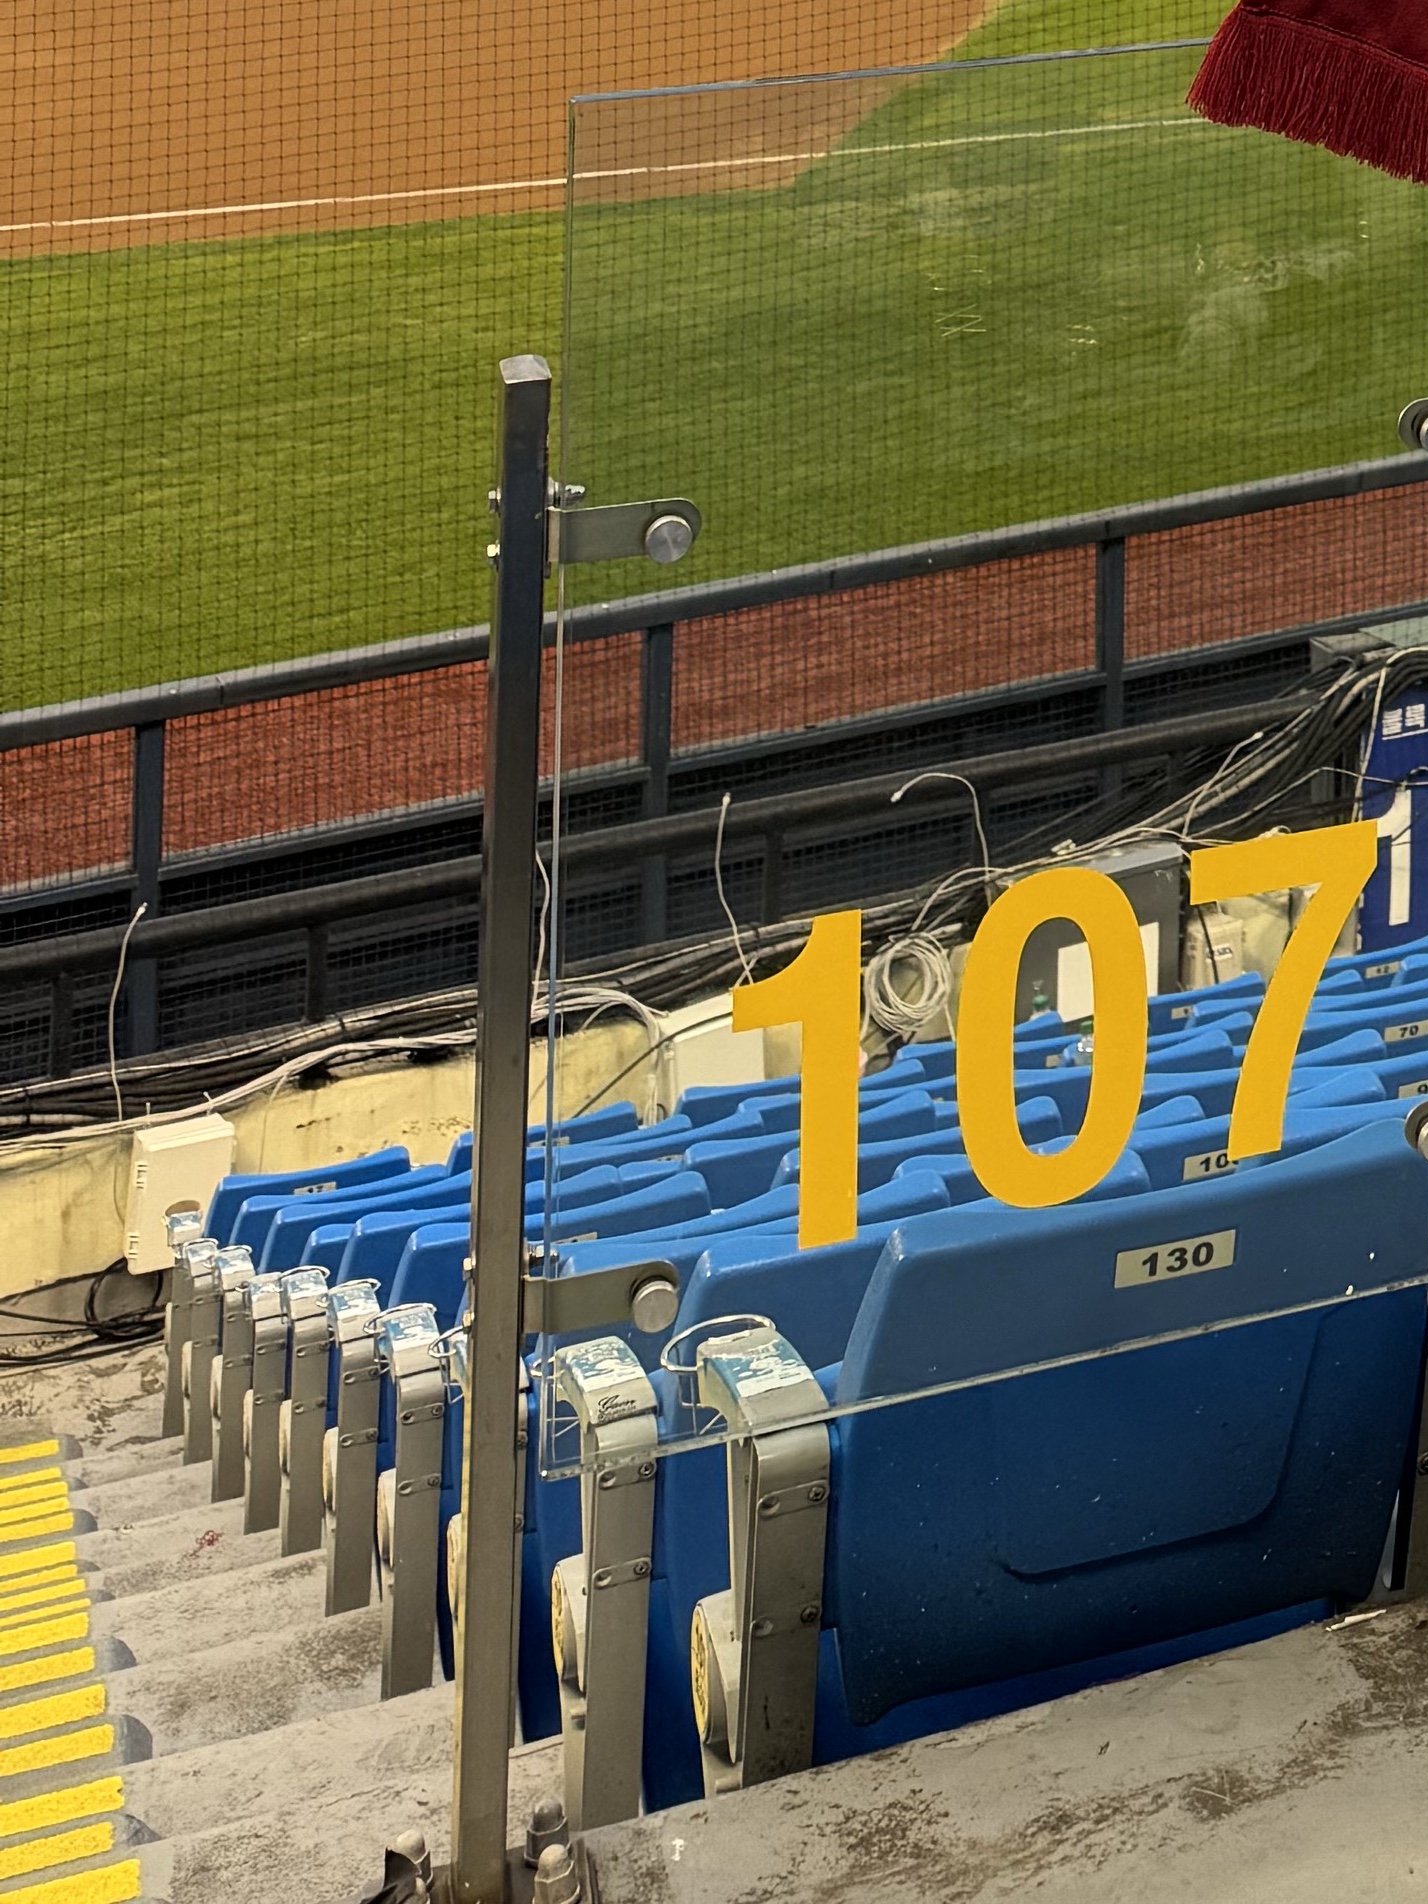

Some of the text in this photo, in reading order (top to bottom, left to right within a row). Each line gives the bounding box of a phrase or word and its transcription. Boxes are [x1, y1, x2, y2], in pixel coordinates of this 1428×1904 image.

[732, 820, 1378, 1250] 107
[1398, 1024, 1420, 1038] 70
[1199, 1149, 1242, 1173] 10
[1140, 1242, 1215, 1278] 130
